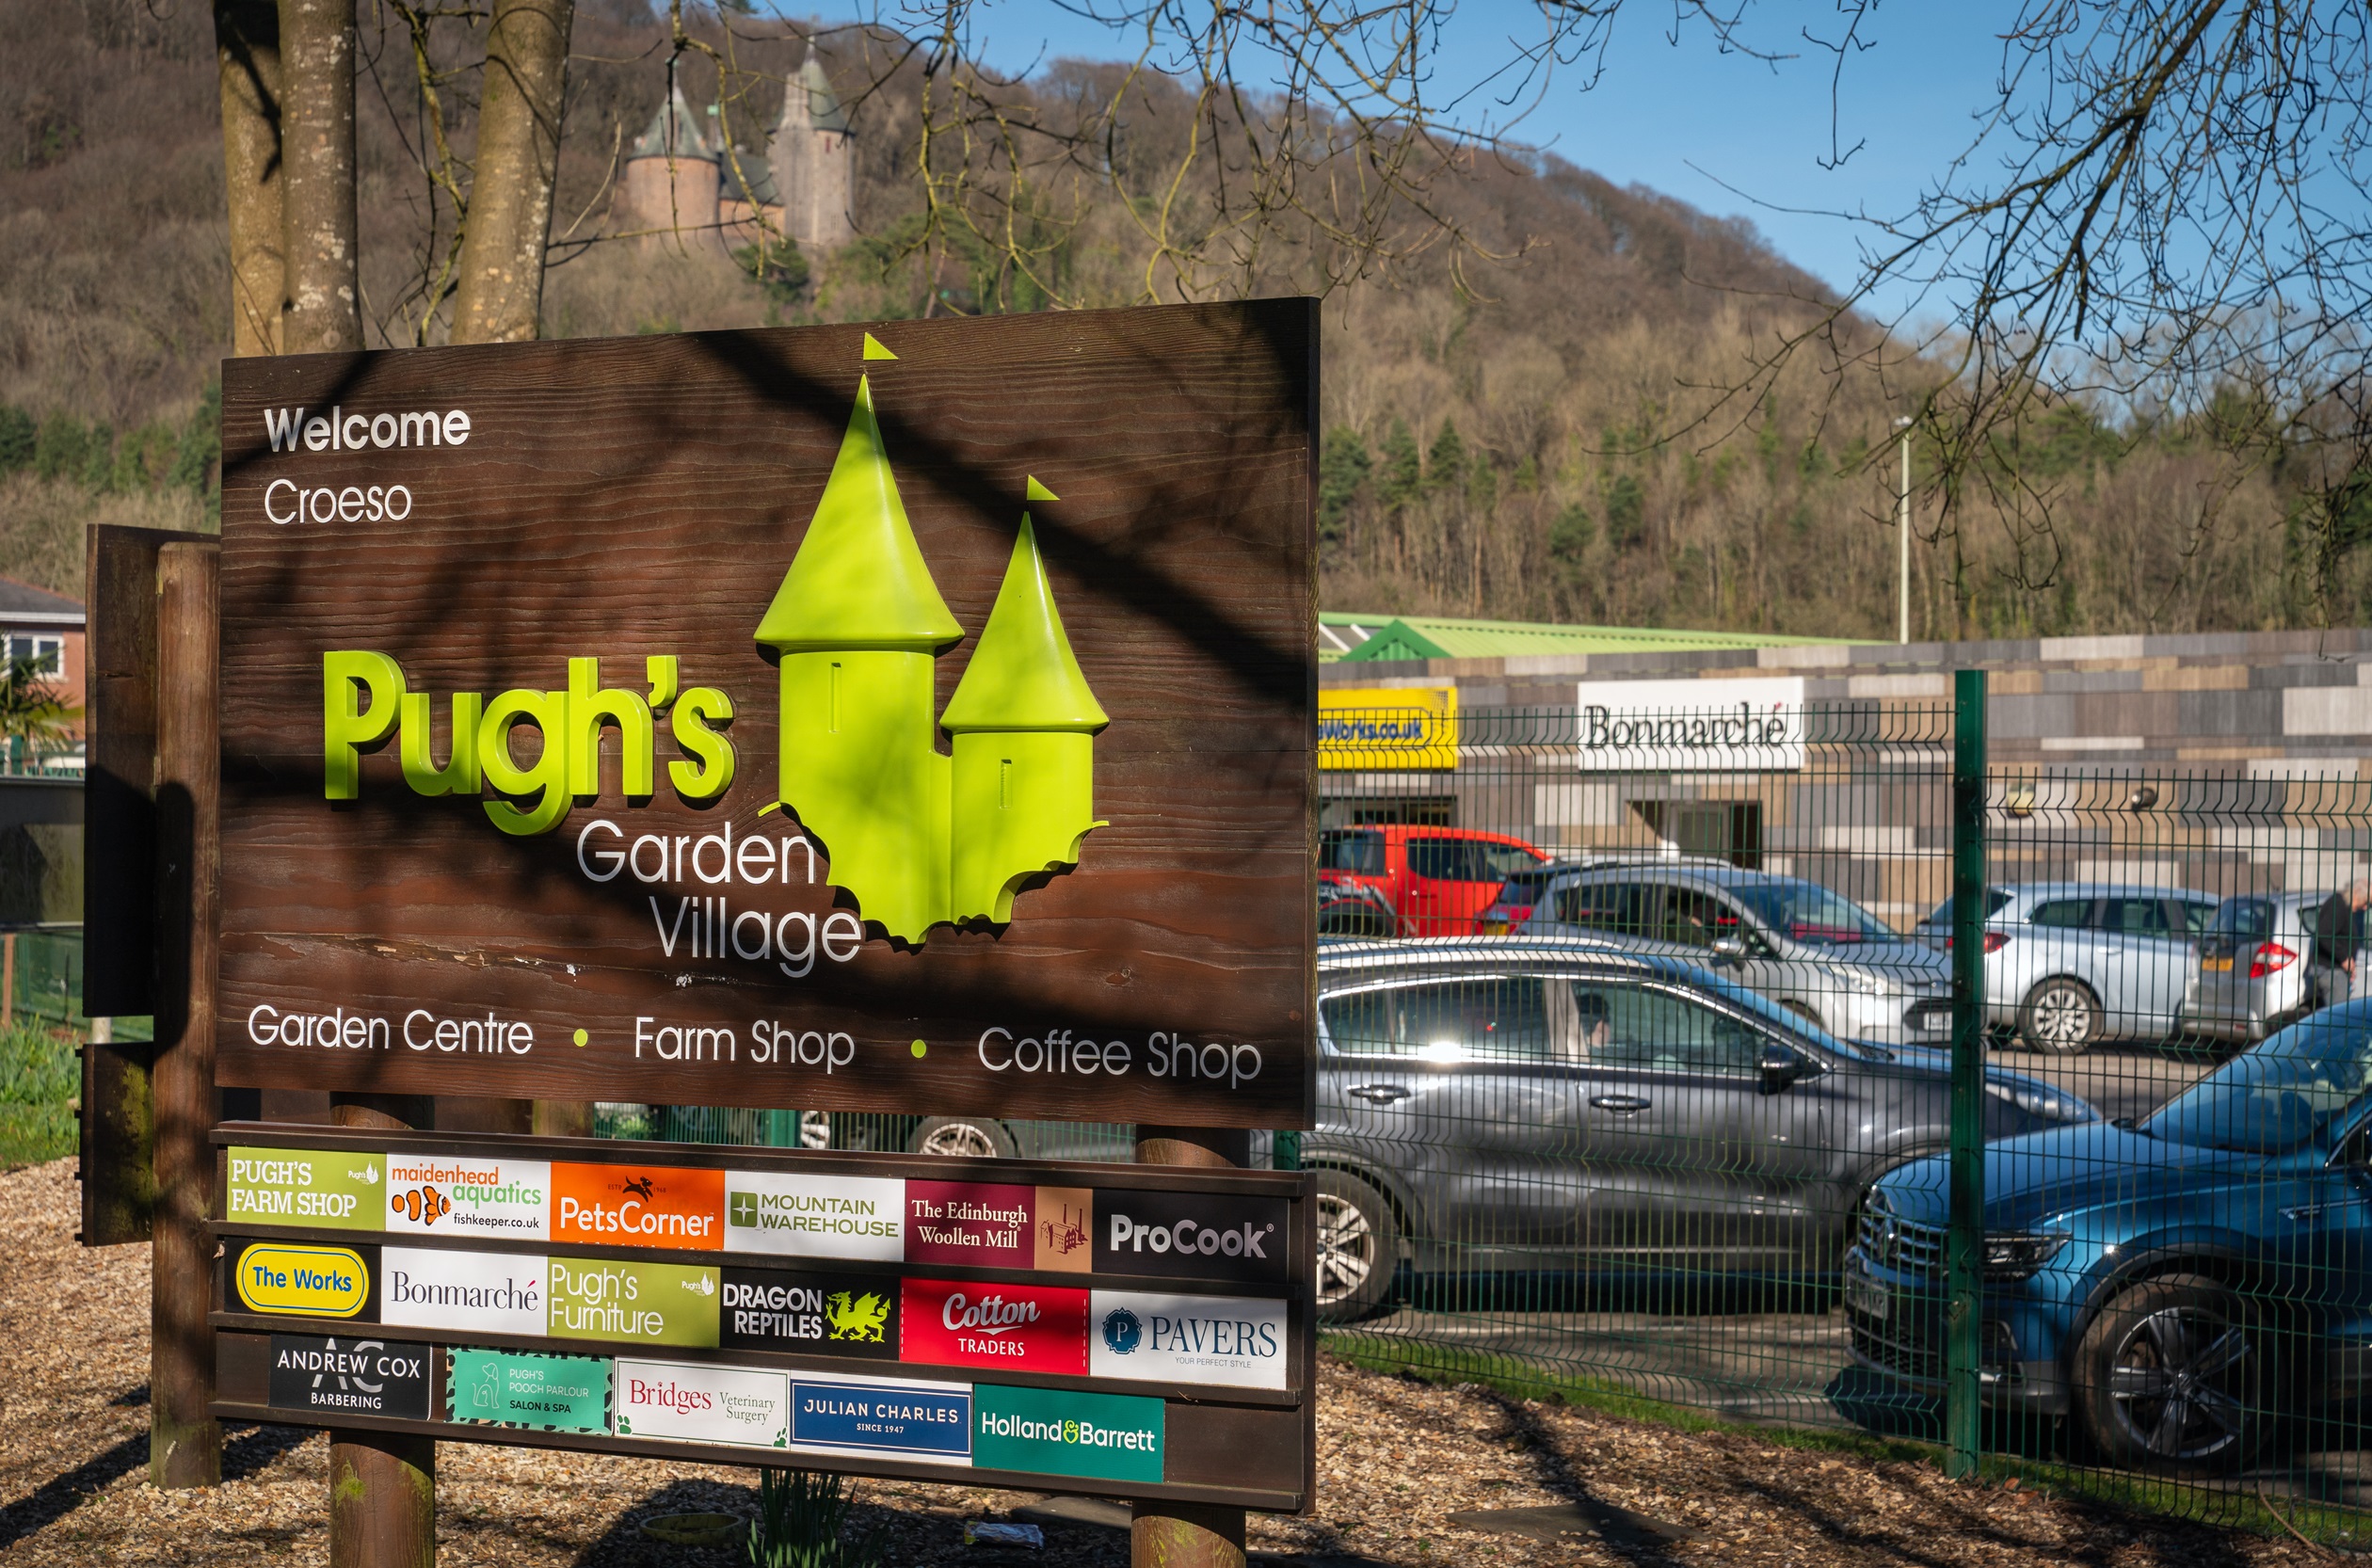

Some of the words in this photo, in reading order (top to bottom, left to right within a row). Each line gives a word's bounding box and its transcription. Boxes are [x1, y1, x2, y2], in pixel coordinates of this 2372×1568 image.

[264, 406, 471, 452] Welcome
[264, 479, 411, 524] Croeso
[1585, 701, 1785, 749] Bonmarché
[324, 650, 735, 836] Pugh's
[577, 820, 815, 885] Garden
[649, 895, 862, 979] Village
[248, 1004, 390, 1050] Garden
[403, 1009, 534, 1056] Centre
[635, 1016, 736, 1062] Farm
[751, 1019, 856, 1075] Shop
[978, 1026, 1132, 1077] Coffee
[1147, 1031, 1262, 1090] Shop
[232, 1160, 313, 1186] PUGH'S
[392, 1163, 499, 1185] maidenhead
[232, 1190, 293, 1215] FARM
[296, 1193, 358, 1218] SHOP
[453, 1180, 541, 1209] aquatics
[761, 1194, 875, 1216] MOUNTAIN
[454, 1213, 540, 1229] fishkeeper.co.uk
[560, 1196, 714, 1237] PetsCorner
[761, 1213, 899, 1238] WAREHOUSE
[911, 1199, 942, 1218] The
[947, 1202, 1028, 1228] Edinburgh
[918, 1225, 981, 1246] Woollen
[986, 1229, 1018, 1248] Mill
[252, 1266, 287, 1288] The
[293, 1269, 352, 1292] Works
[391, 1271, 538, 1311] Bonmarché
[551, 1263, 638, 1305] Pugh's
[723, 1283, 822, 1313] DRAGON
[942, 1293, 1040, 1331] Cotton
[551, 1297, 664, 1336] Furniture
[734, 1311, 823, 1339] REPTILES
[1116, 1321, 1129, 1342] P
[1150, 1316, 1277, 1358] PAVERS
[957, 1337, 1025, 1357] TRADERS
[277, 1350, 369, 1374] ANDREW
[377, 1356, 421, 1379] COX
[509, 1368, 544, 1381] PUGH'S
[1175, 1356, 1194, 1365] YOUR
[1196, 1358, 1228, 1367] PERFECT
[1229, 1360, 1252, 1368] STYLE
[311, 1392, 382, 1410] BARBERING
[509, 1382, 544, 1394] POOCH
[546, 1384, 589, 1398] PARLOUR
[629, 1379, 713, 1416] Bridges
[719, 1392, 776, 1413] Veterinary
[509, 1400, 542, 1411] SALON
[543, 1402, 551, 1412] &
[553, 1403, 571, 1414] SPA
[726, 1406, 769, 1425] Surgery
[804, 1399, 869, 1416] JULIAN
[875, 1404, 959, 1424] CHARLES
[857, 1423, 882, 1432] SINCE
[885, 1425, 905, 1434] 1947
